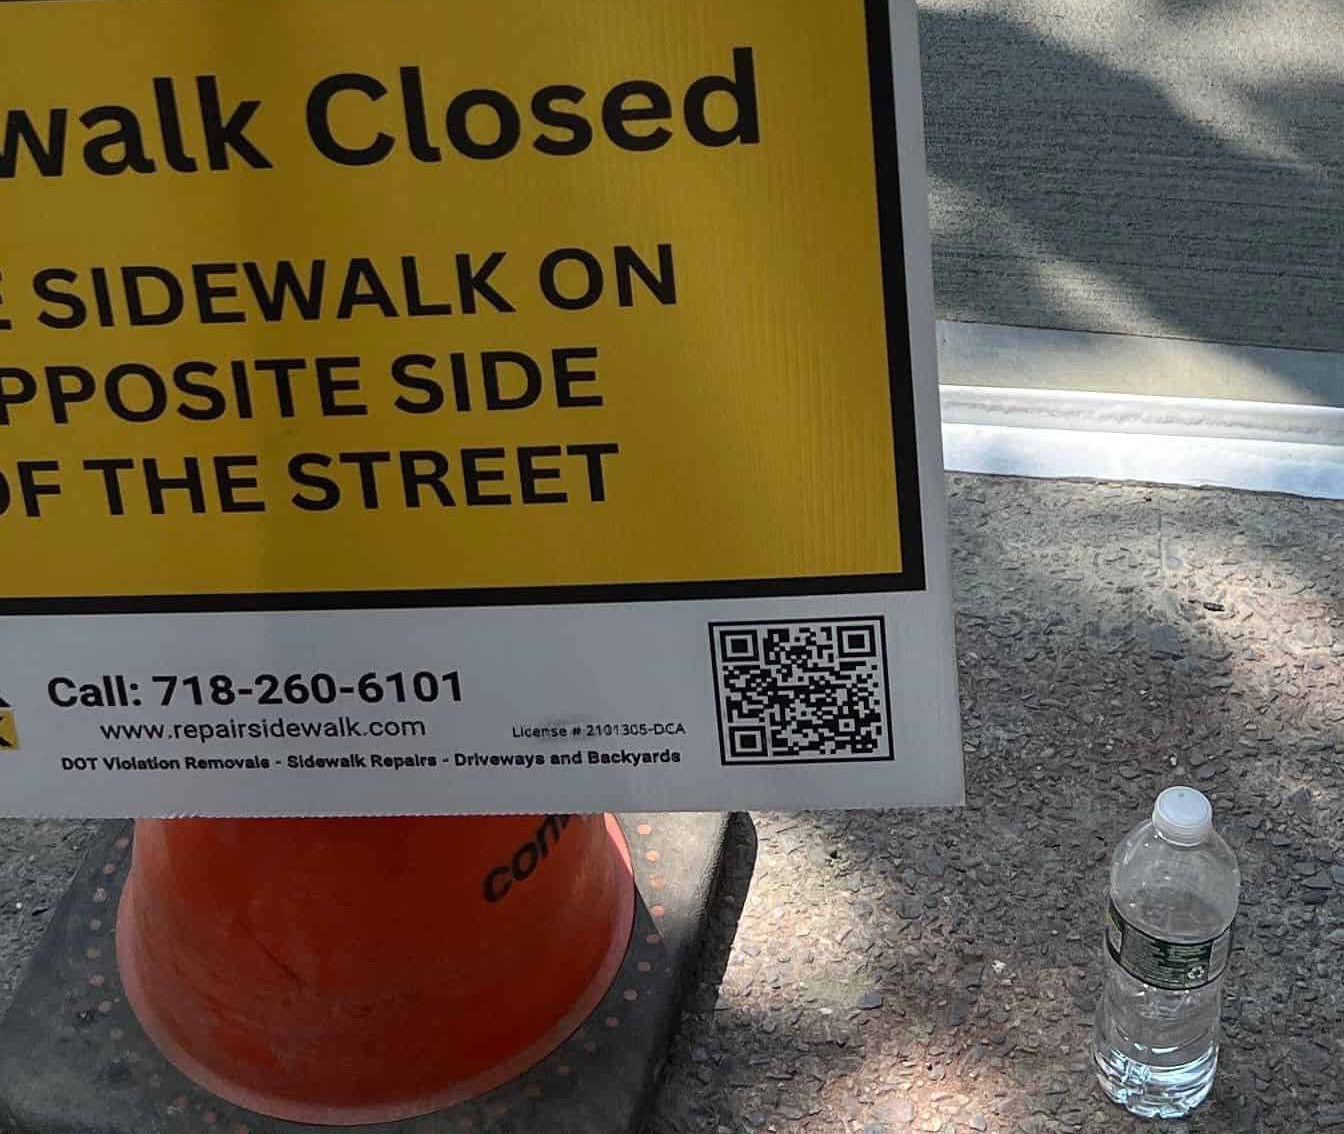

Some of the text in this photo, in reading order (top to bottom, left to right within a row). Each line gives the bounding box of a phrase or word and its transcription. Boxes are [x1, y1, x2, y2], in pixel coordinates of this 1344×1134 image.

[305, 46, 761, 167] Closed
[32, 251, 517, 329] SIDEWALK
[539, 243, 677, 311] ON
[391, 347, 604, 414] SIDE
[82, 455, 266, 516] THE
[287, 443, 620, 512] STREET
[47, 670, 462, 708] Call: 718-260-6101
[61, 757, 98, 771] DOT
[102, 756, 181, 771] Violation
[184, 755, 270, 770] Removals
[287, 753, 367, 769] Sidewalk
[370, 753, 437, 771] Repairs
[454, 753, 545, 769] Driveways
[550, 750, 583, 765] and
[587, 748, 681, 767] Backyards
[99, 716, 426, 744] www.repairsidewalk.com
[512, 726, 568, 738] License
[483, 814, 572, 903] con
